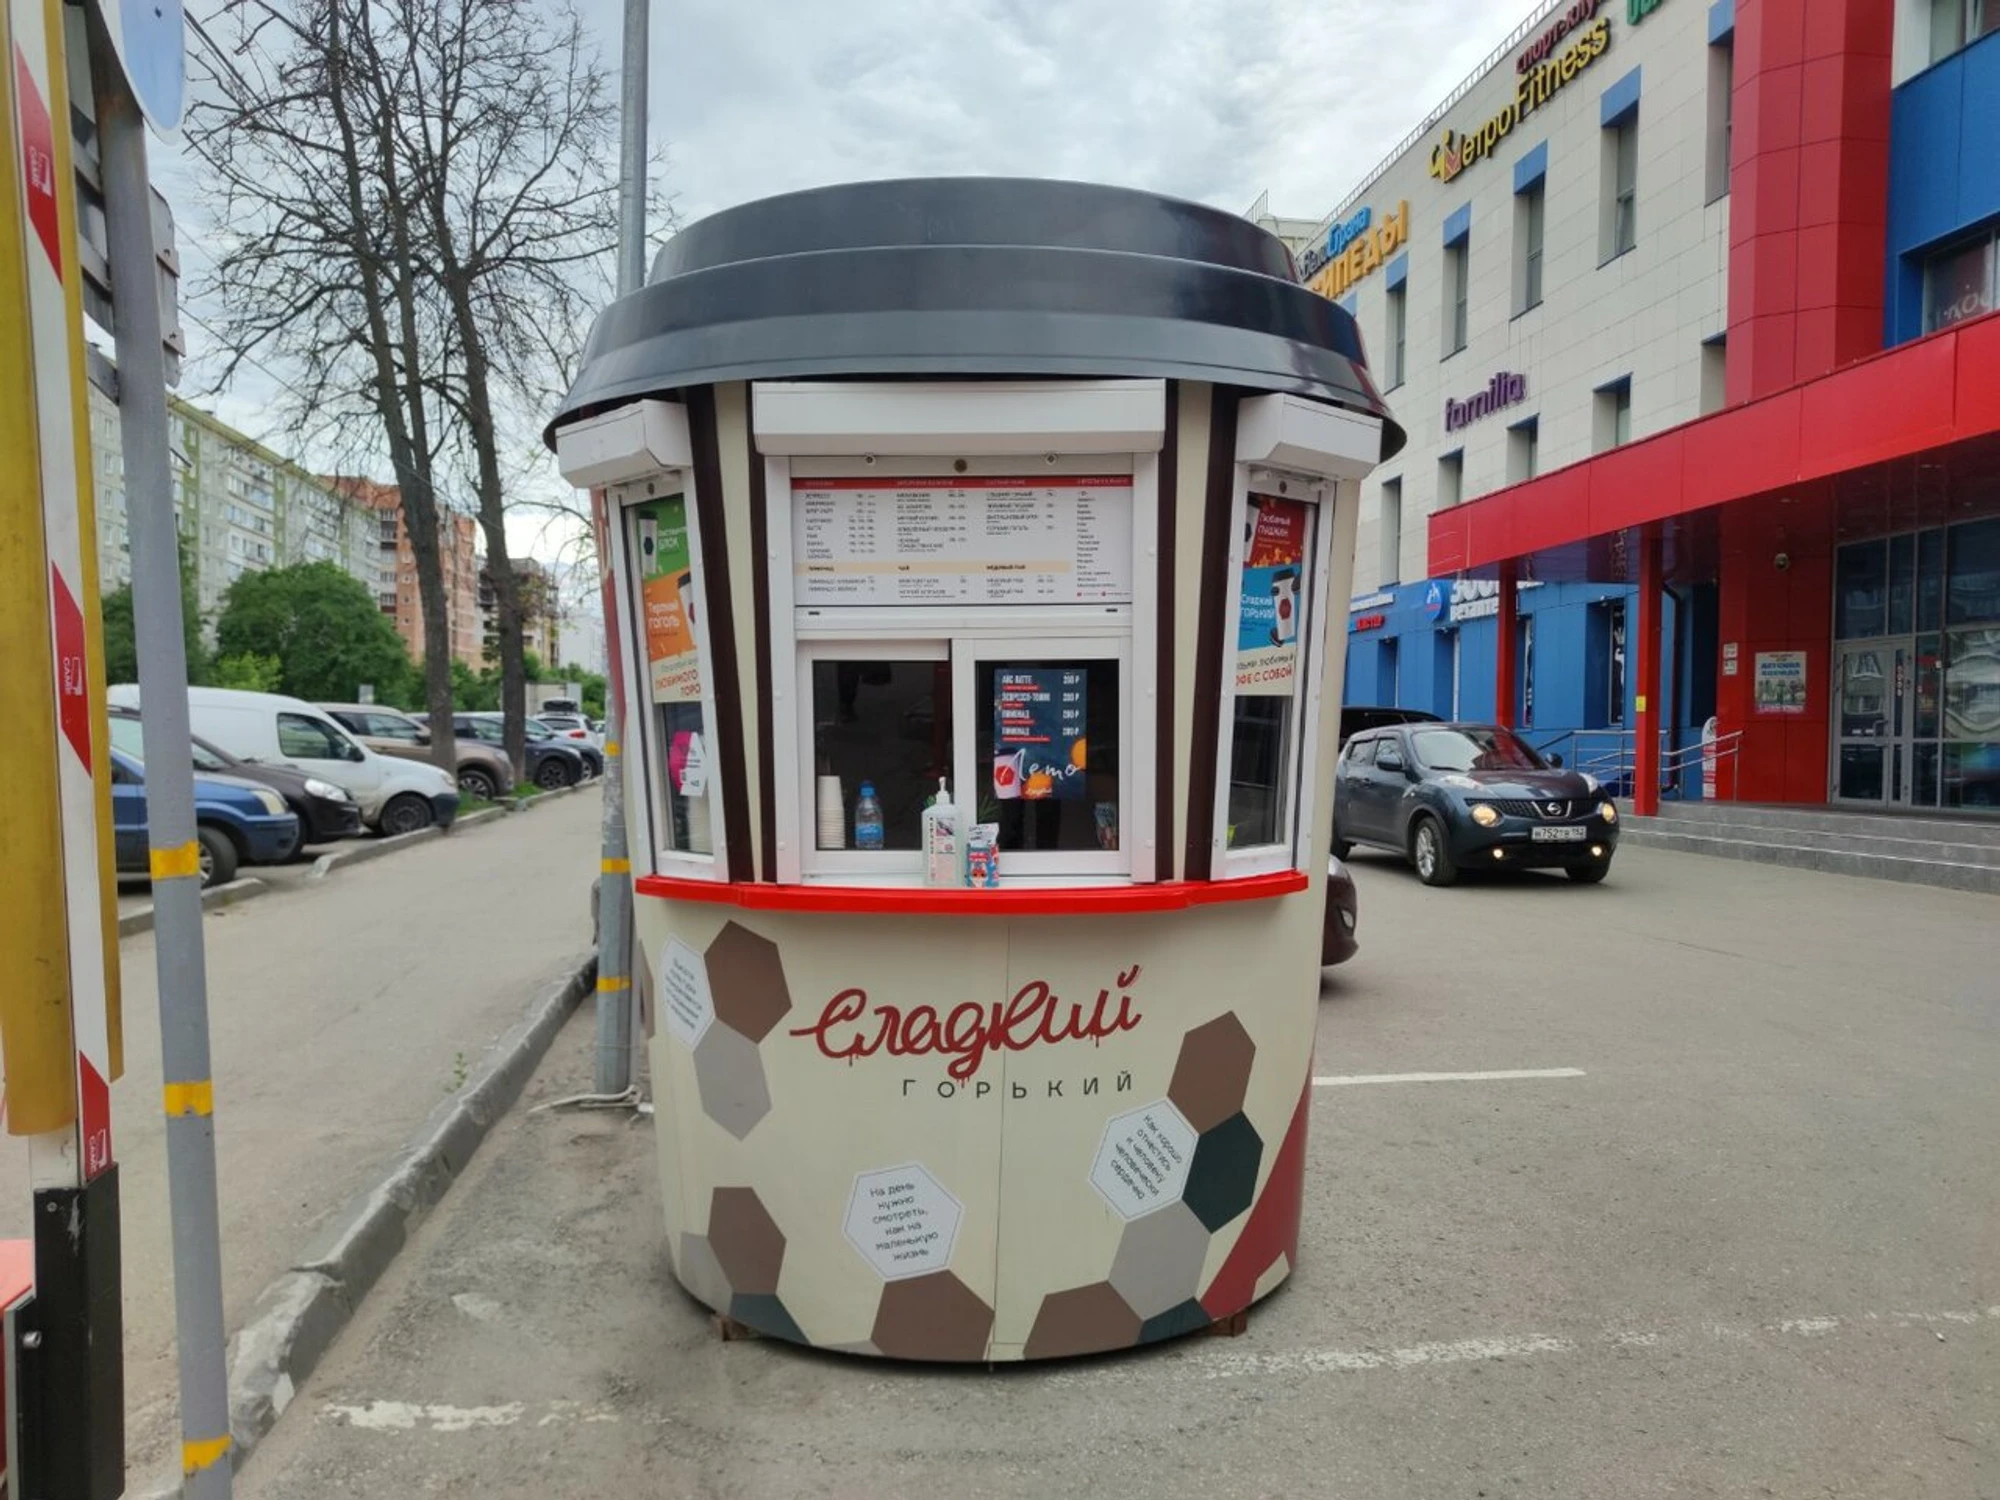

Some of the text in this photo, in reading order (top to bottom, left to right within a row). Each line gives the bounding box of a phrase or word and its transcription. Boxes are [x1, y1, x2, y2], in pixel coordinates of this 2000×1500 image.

[1313, 199, 1409, 299] ИПЕДЫ
[1446, 371, 1526, 432] familia
[63, 657, 72, 696] CAME
[789, 964, 1143, 1082] Сладкий
[903, 1071, 1132, 1099] ГОРЬКИЙ
[869, 1183, 915, 1197] На день
[877, 1196, 915, 1210] нужно
[907, 1222, 922, 1231] на
[875, 1231, 939, 1250] маленькую
[893, 1249, 929, 1261] жизнь
